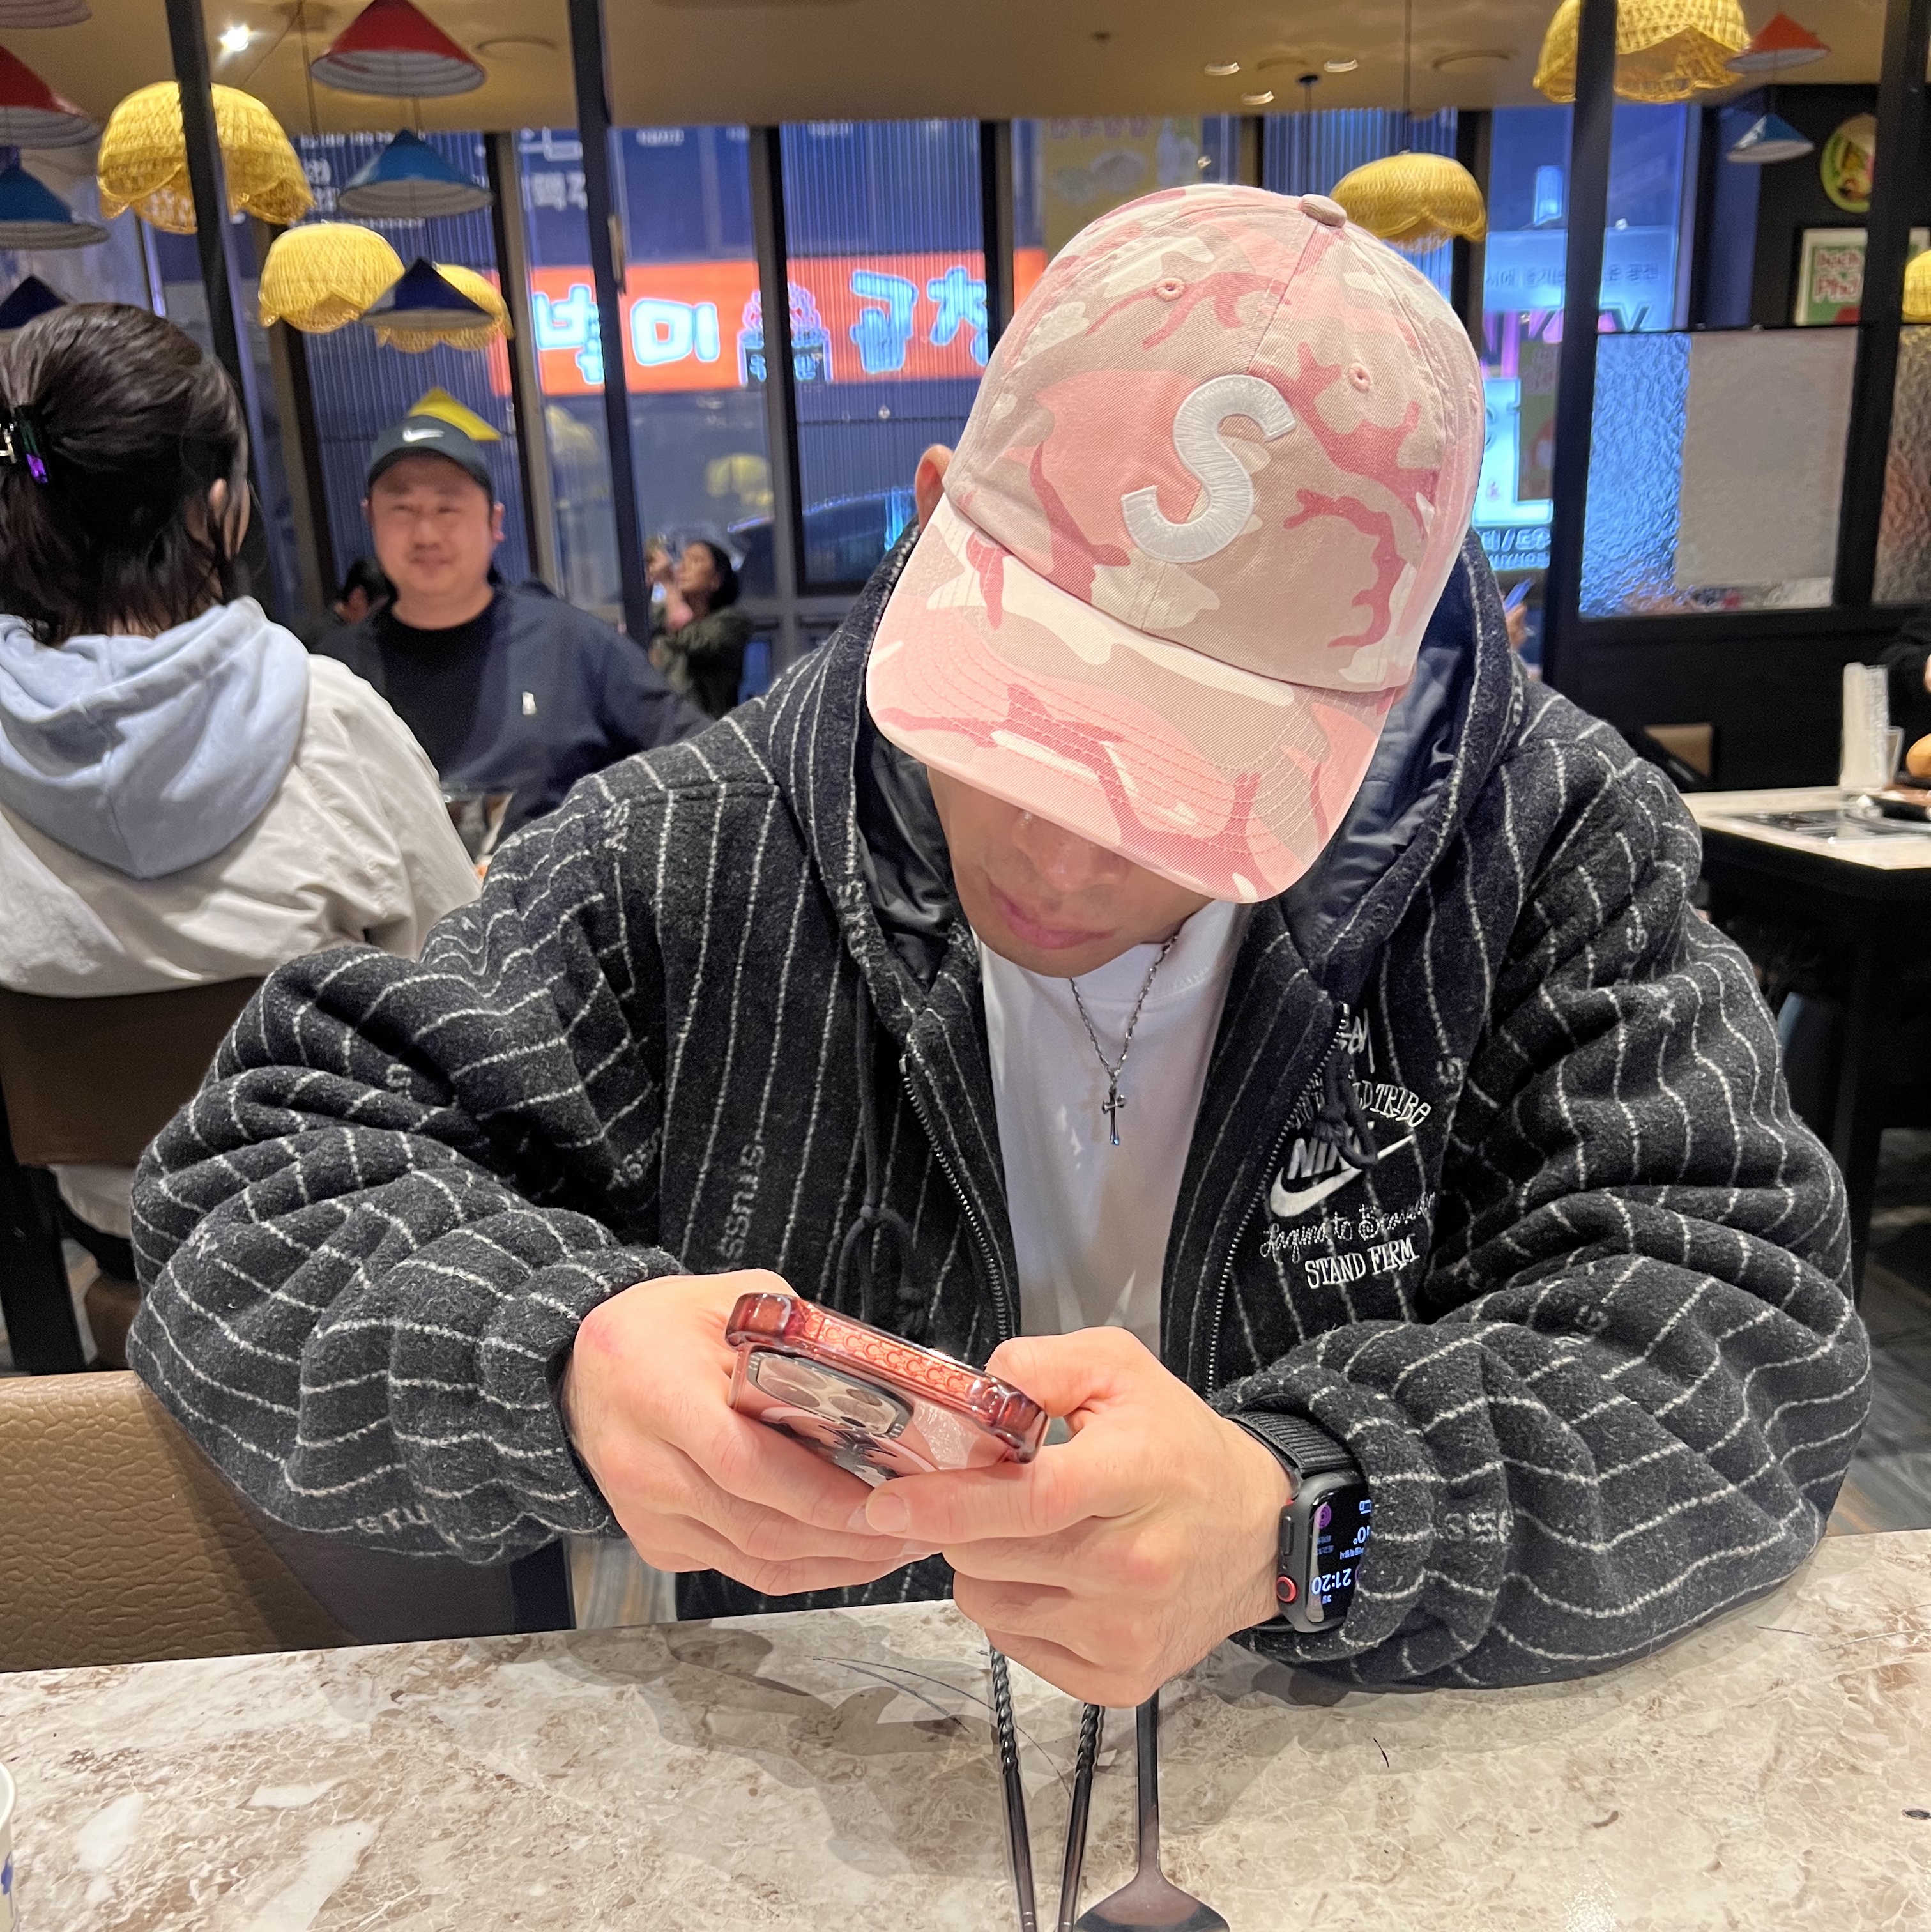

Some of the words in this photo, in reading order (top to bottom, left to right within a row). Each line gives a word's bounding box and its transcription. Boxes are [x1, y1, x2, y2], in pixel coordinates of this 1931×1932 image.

[1121, 374, 1296, 563] S
[1304, 1252, 1366, 1289] STAND
[1366, 1233, 1421, 1275] FIRM
[1311, 1568, 1352, 1595] 21:20
